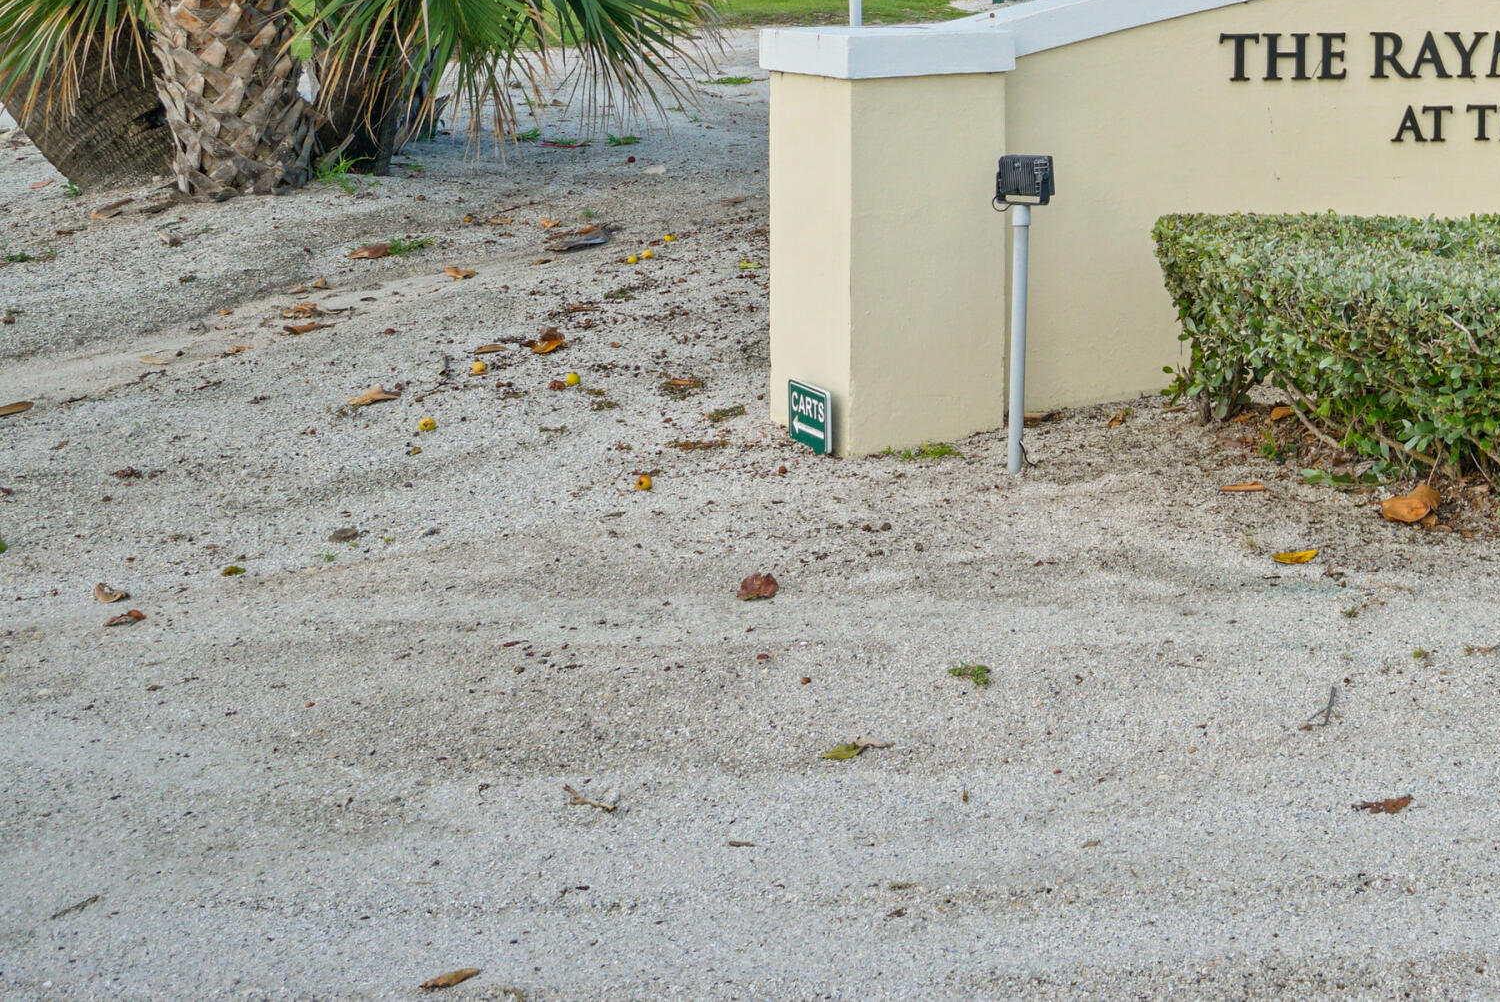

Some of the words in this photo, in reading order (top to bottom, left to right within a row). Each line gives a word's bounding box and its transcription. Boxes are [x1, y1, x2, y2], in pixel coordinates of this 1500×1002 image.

[1219, 32, 1348, 82] THE
[1390, 105, 1454, 143] AT
[791, 391, 824, 423] CARTS
